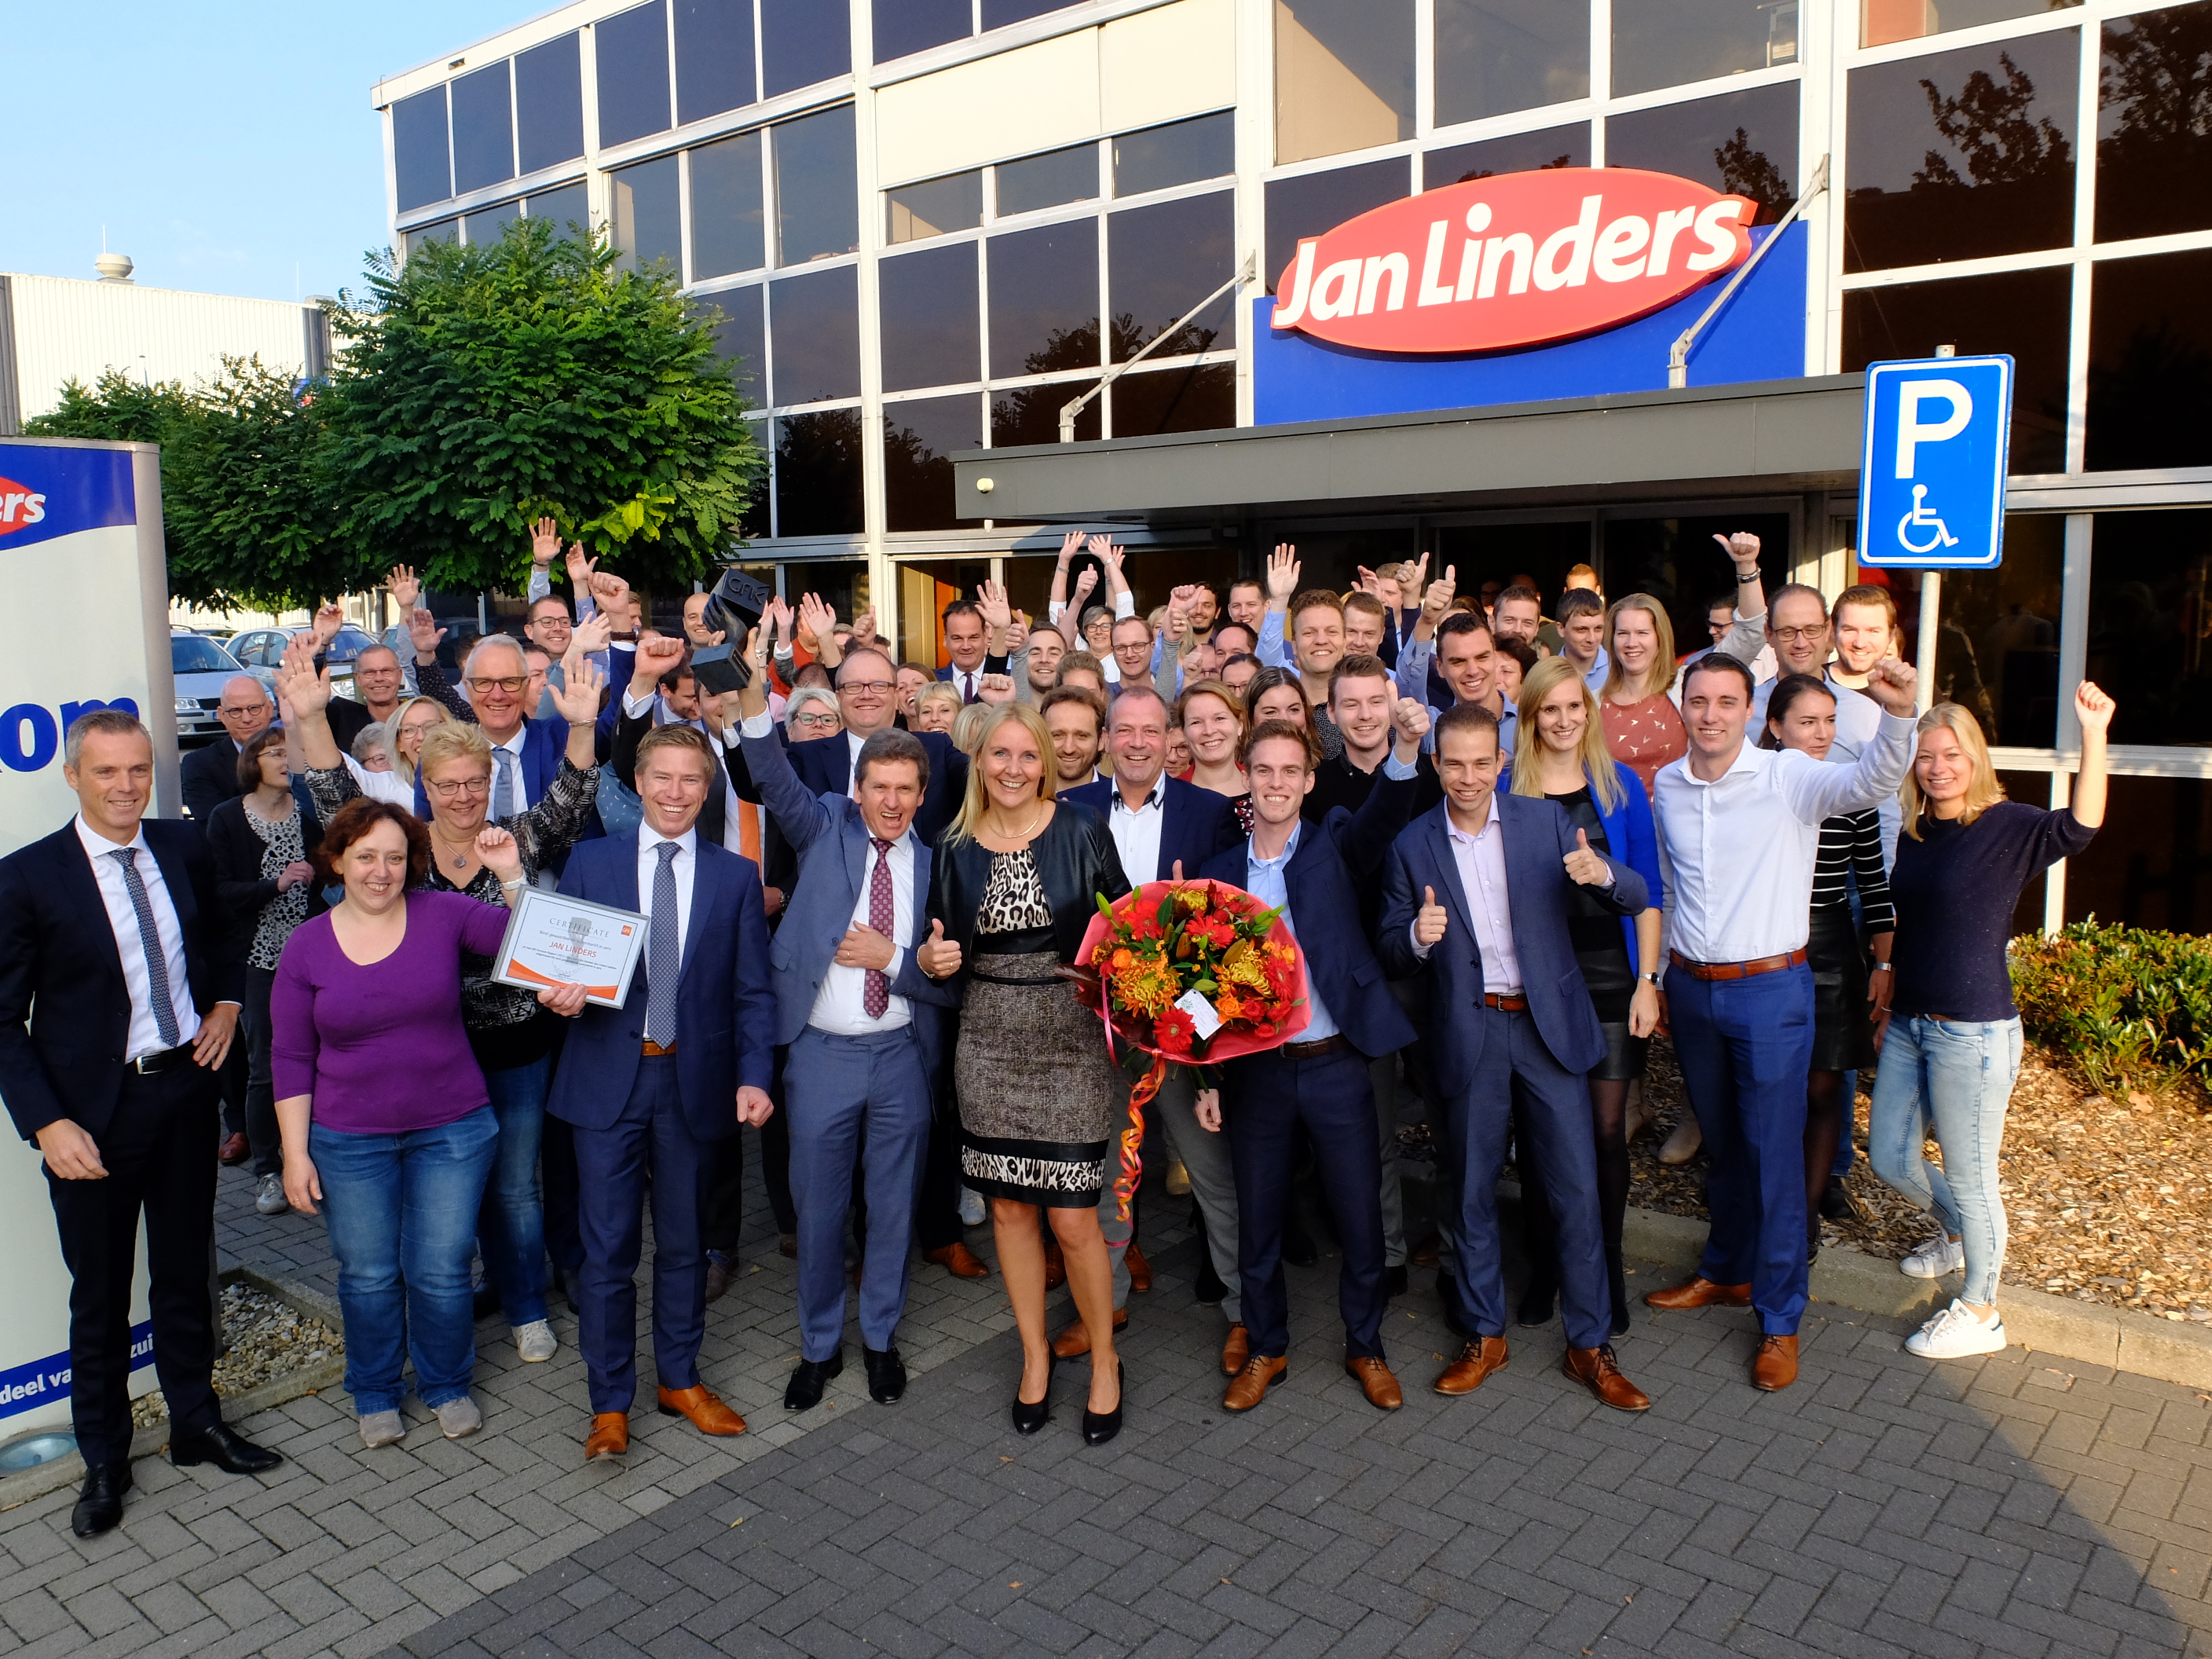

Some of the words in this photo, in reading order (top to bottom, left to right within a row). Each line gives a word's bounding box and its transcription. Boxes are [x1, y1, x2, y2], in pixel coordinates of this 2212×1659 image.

[1273, 242, 1409, 327] Jan
[1417, 194, 1743, 307] Linders
[1895, 379, 1973, 479] P
[549, 917, 610, 938] CERTIFICATE
[549, 941, 565, 950] JAN
[565, 944, 597, 958] LINDERS
